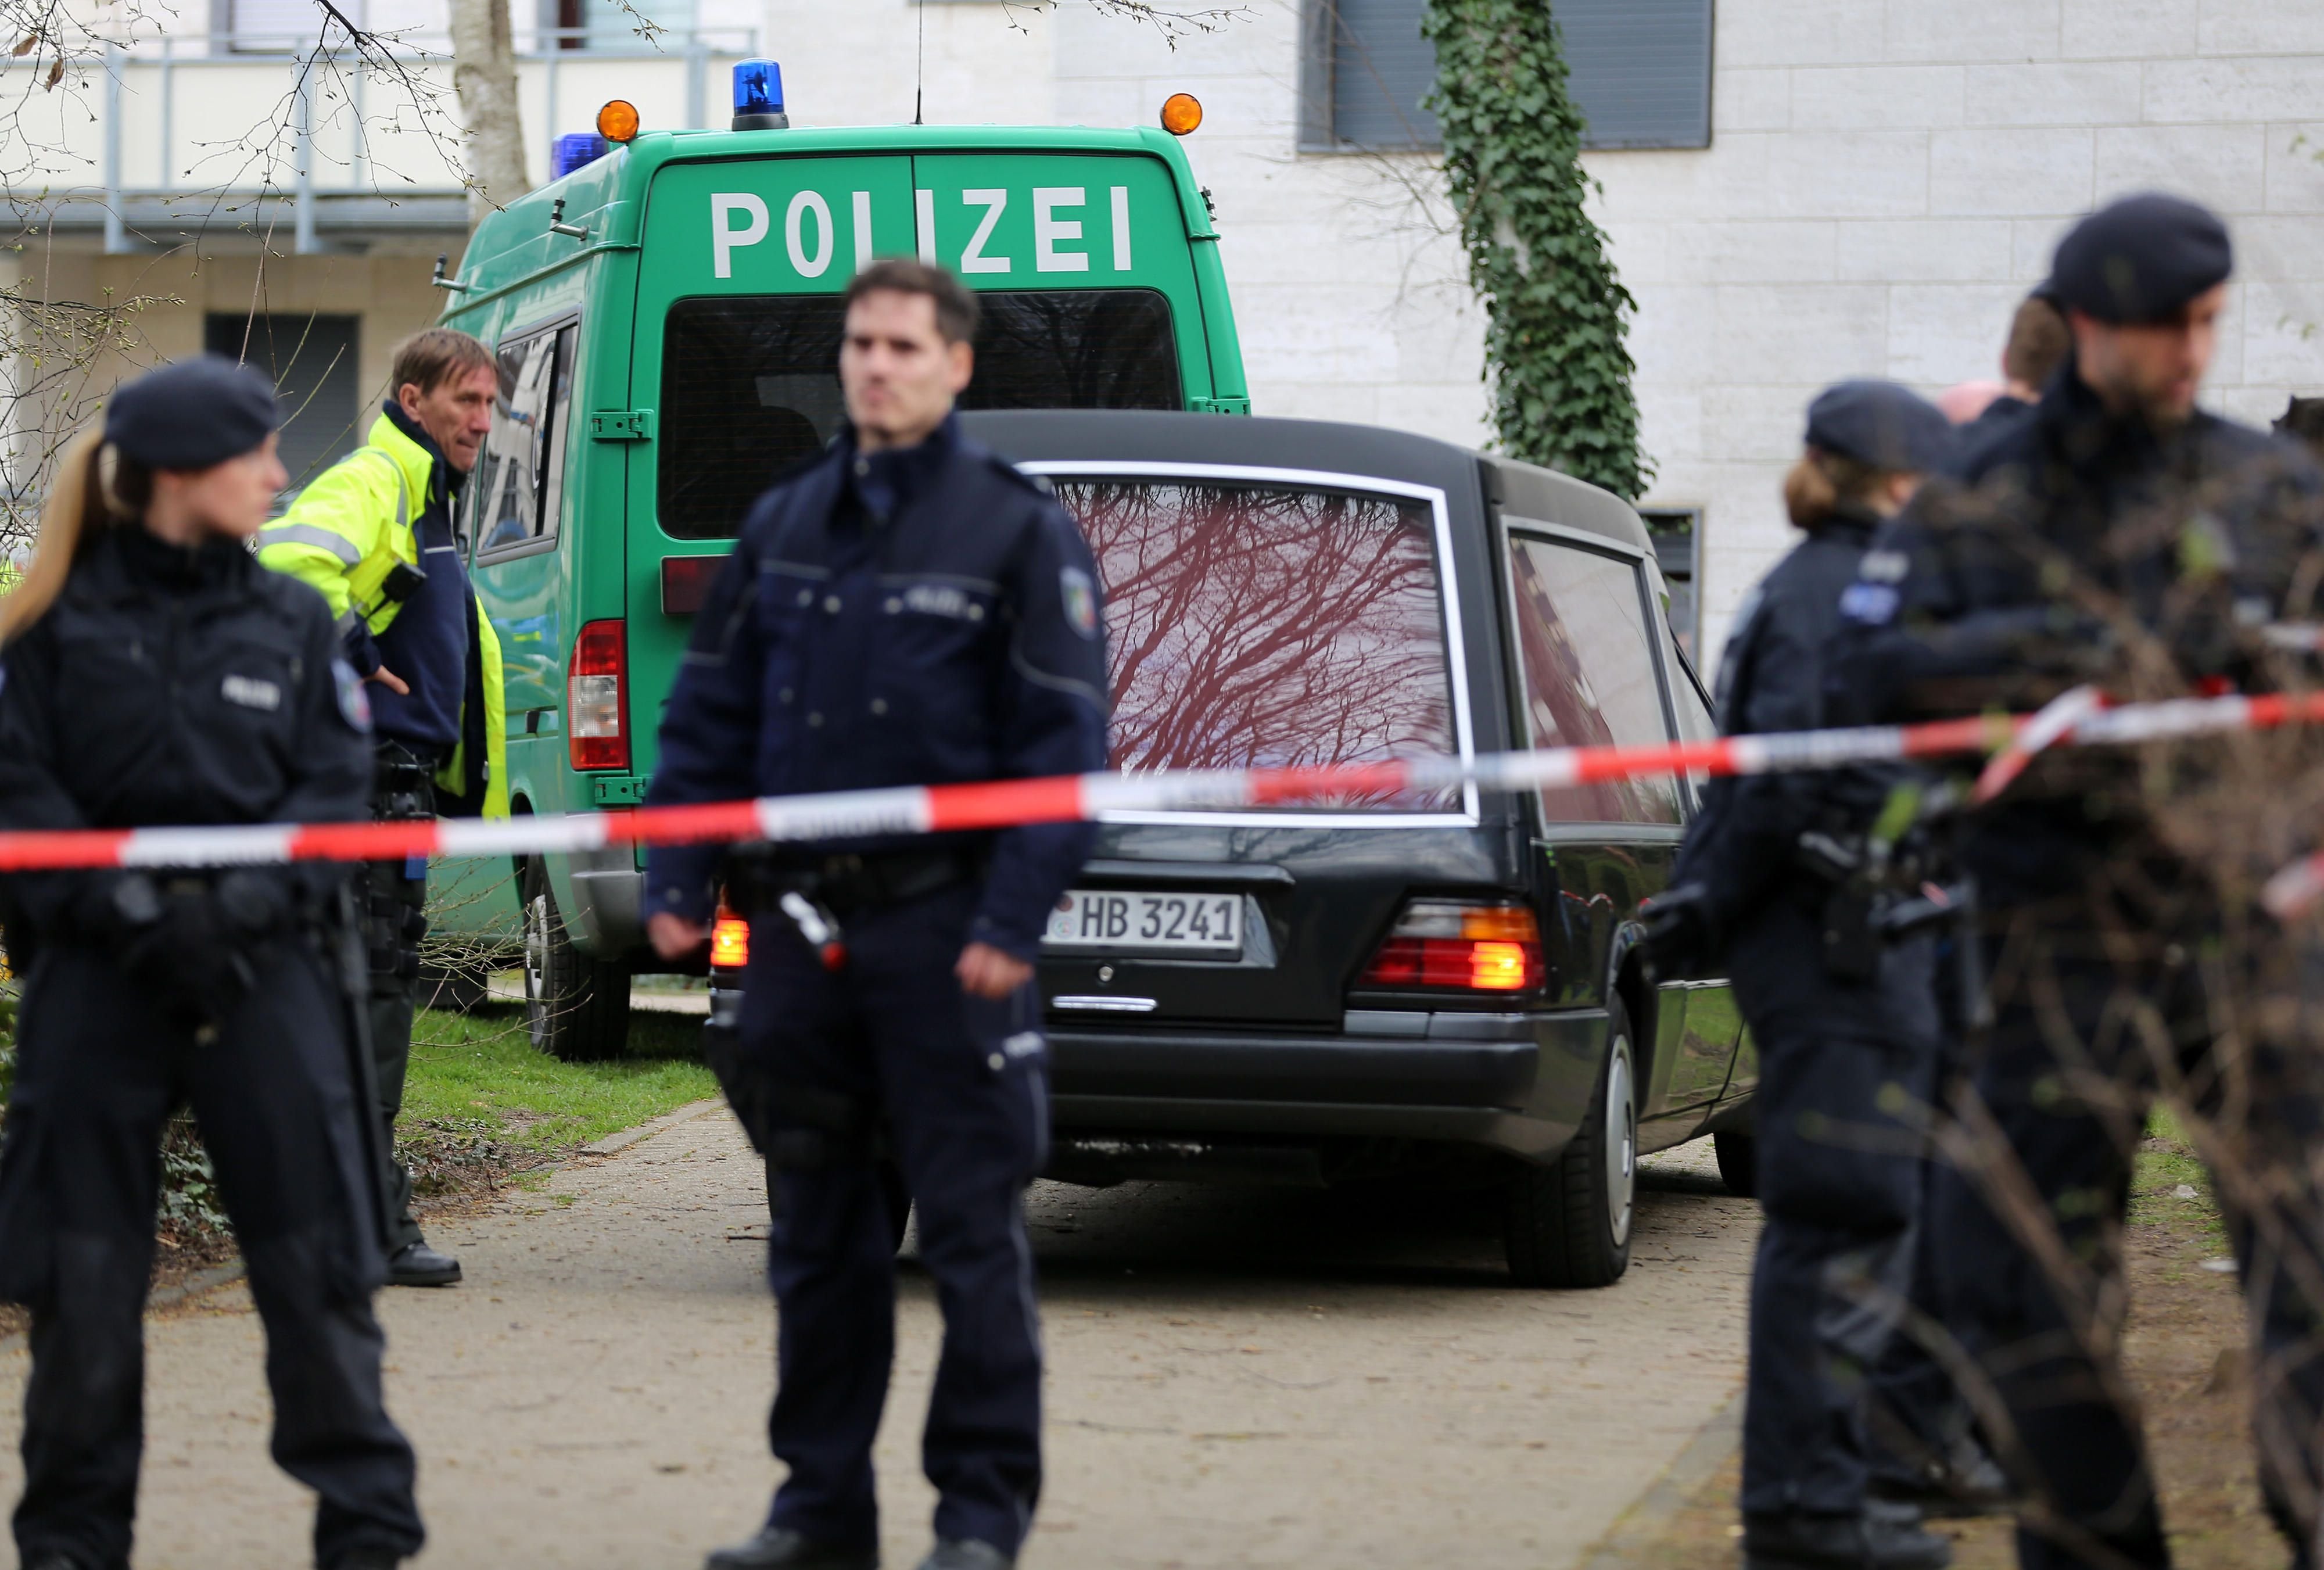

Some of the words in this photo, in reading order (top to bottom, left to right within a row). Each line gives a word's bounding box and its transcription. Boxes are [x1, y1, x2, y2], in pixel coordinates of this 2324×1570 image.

[711, 185, 1132, 279] POLIZEI
[1081, 896, 1129, 938] HB
[1140, 898, 1233, 941] 3241
